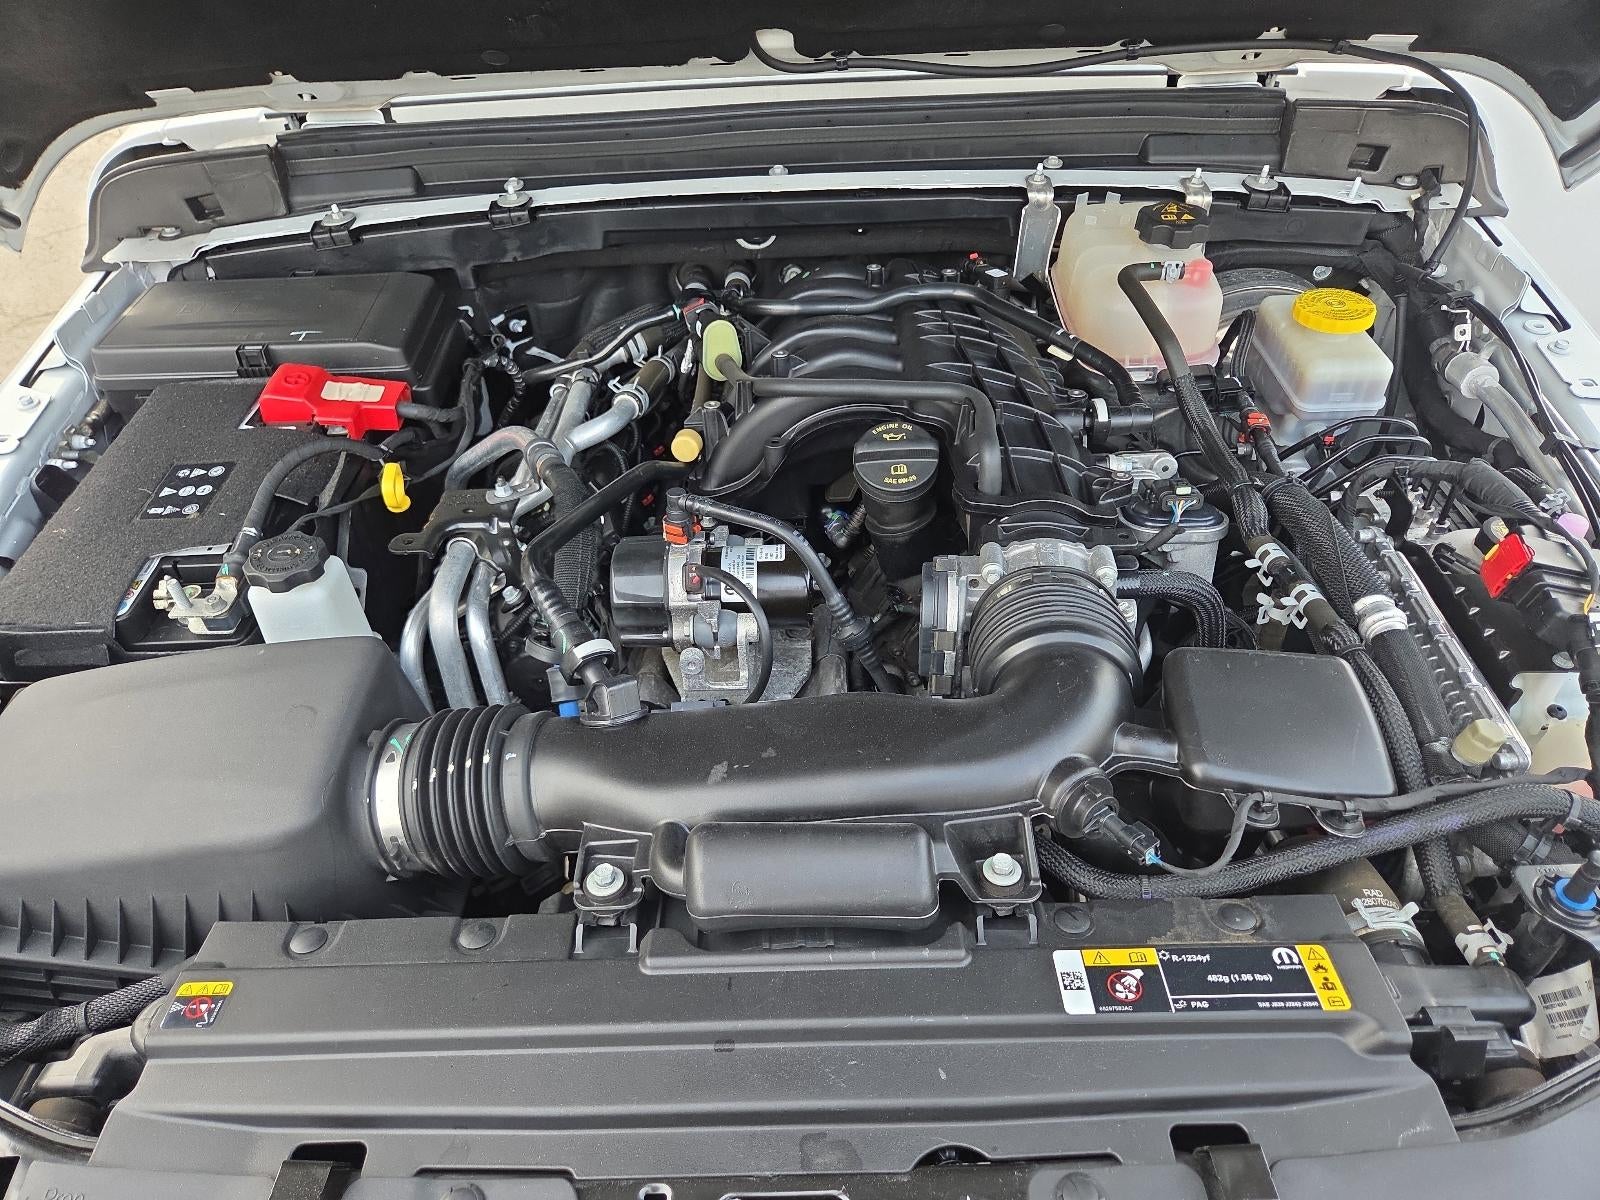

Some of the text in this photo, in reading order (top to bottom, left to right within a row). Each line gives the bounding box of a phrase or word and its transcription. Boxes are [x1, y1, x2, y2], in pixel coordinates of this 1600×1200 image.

[872, 423, 913, 435] ENGINE OIL
[884, 476, 897, 484] SAE
[1362, 888, 1384, 898] RAD
[1171, 953, 1211, 963] R-1234yf
[1207, 974, 1230, 983] 482g
[1255, 973, 1273, 983] lbs)
[1190, 1001, 1210, 1009] PAG
